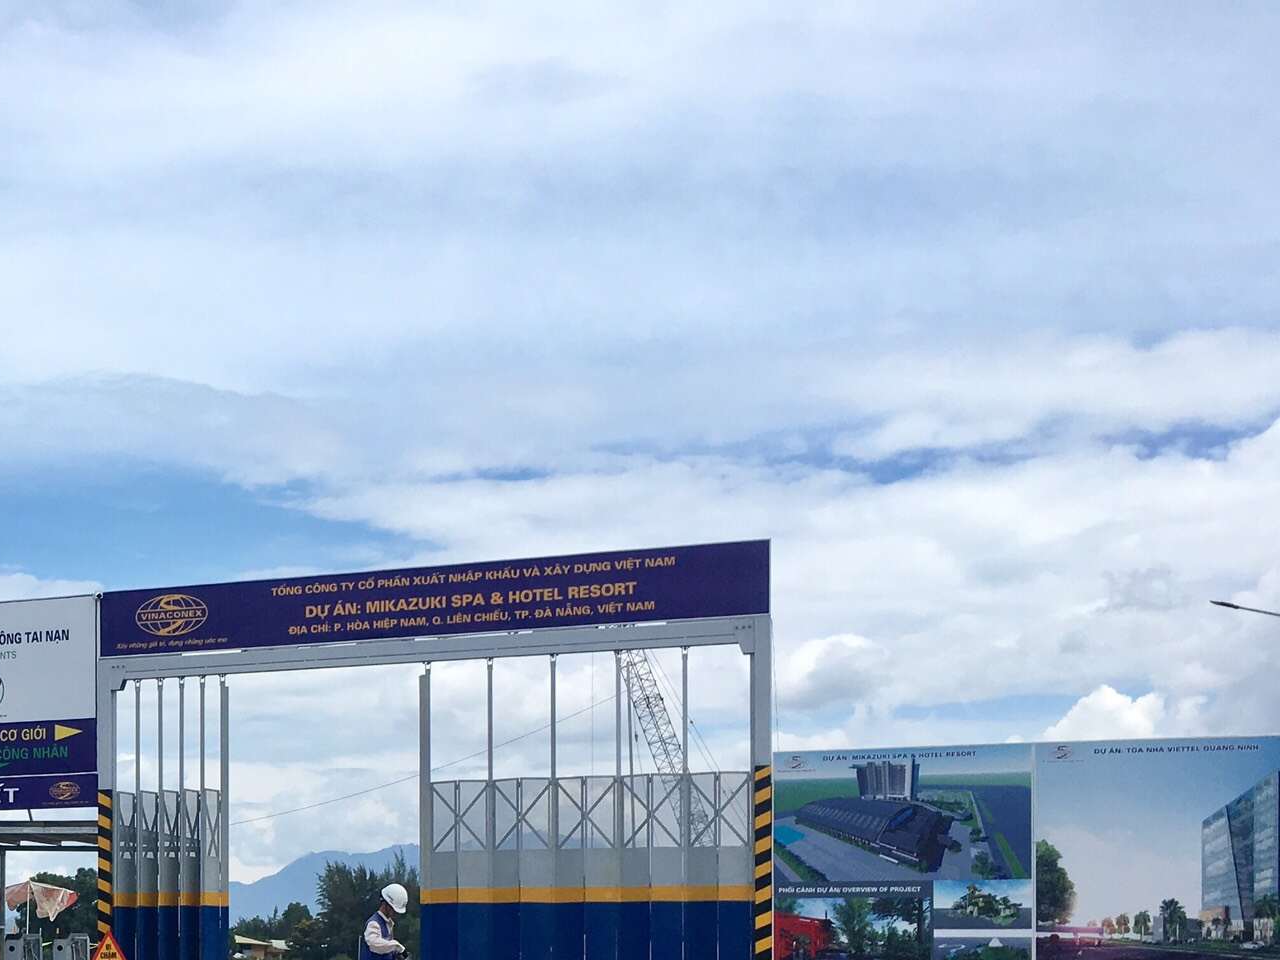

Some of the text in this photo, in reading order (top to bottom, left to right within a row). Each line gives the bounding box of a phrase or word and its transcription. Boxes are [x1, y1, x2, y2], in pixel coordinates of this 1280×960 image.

[271, 556, 676, 596] TỔNG CÔNG TY CỔ PHẦN XUẤT NHẬP KHẨU VÀ XÂY DỰNG VIỆT NAM
[304, 582, 638, 619] DỰ ÁN: MIKAZUKI SPA & HOTEL RESORT
[141, 608, 203, 621] VINACONEX
[288, 626, 308, 636] ĐỊA
[334, 623, 344, 632] P.
[347, 621, 370, 631] HÒA
[373, 617, 398, 630] HIỆP
[400, 616, 429, 627] NAM,
[432, 616, 444, 625] Q.
[447, 614, 471, 624] LIÊN
[515, 609, 532, 619] TP.
[535, 605, 553, 618] ĐÀ
[555, 602, 594, 616] NẴNG,
[597, 602, 624, 614] VIỆT
[626, 601, 655, 611] NAM
[24, 631, 43, 643] TAI
[45, 629, 70, 644] NẠN
[0, 728, 18, 741] CƠ
[21, 725, 46, 740] GIỚI
[32, 744, 68, 758] NHÂN
[1167, 745, 1200, 753] VIETTEL
[890, 885, 922, 893] PROJECT
